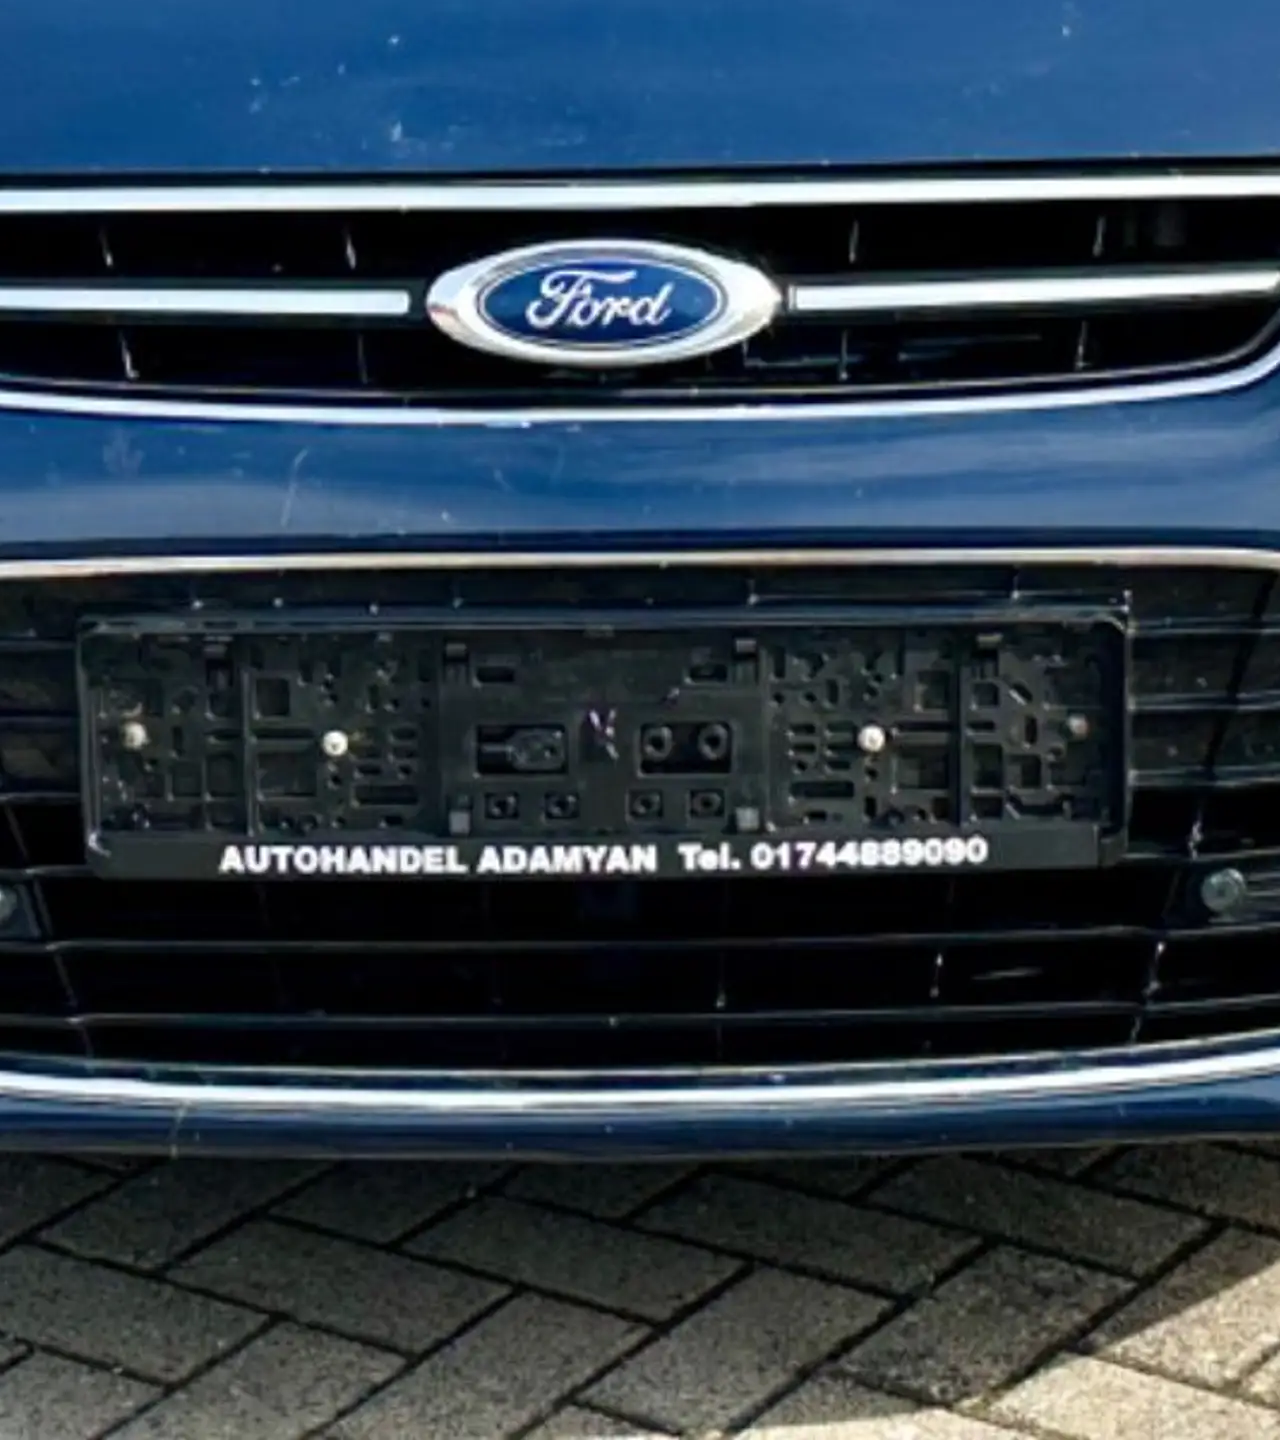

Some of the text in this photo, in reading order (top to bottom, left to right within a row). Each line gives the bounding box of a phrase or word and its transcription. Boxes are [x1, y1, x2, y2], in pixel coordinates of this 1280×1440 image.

[525, 268, 675, 330] Ford
[219, 845, 468, 874] AUTOHANDEL
[476, 843, 657, 874] ADAMYAN
[677, 842, 741, 871] Tel.
